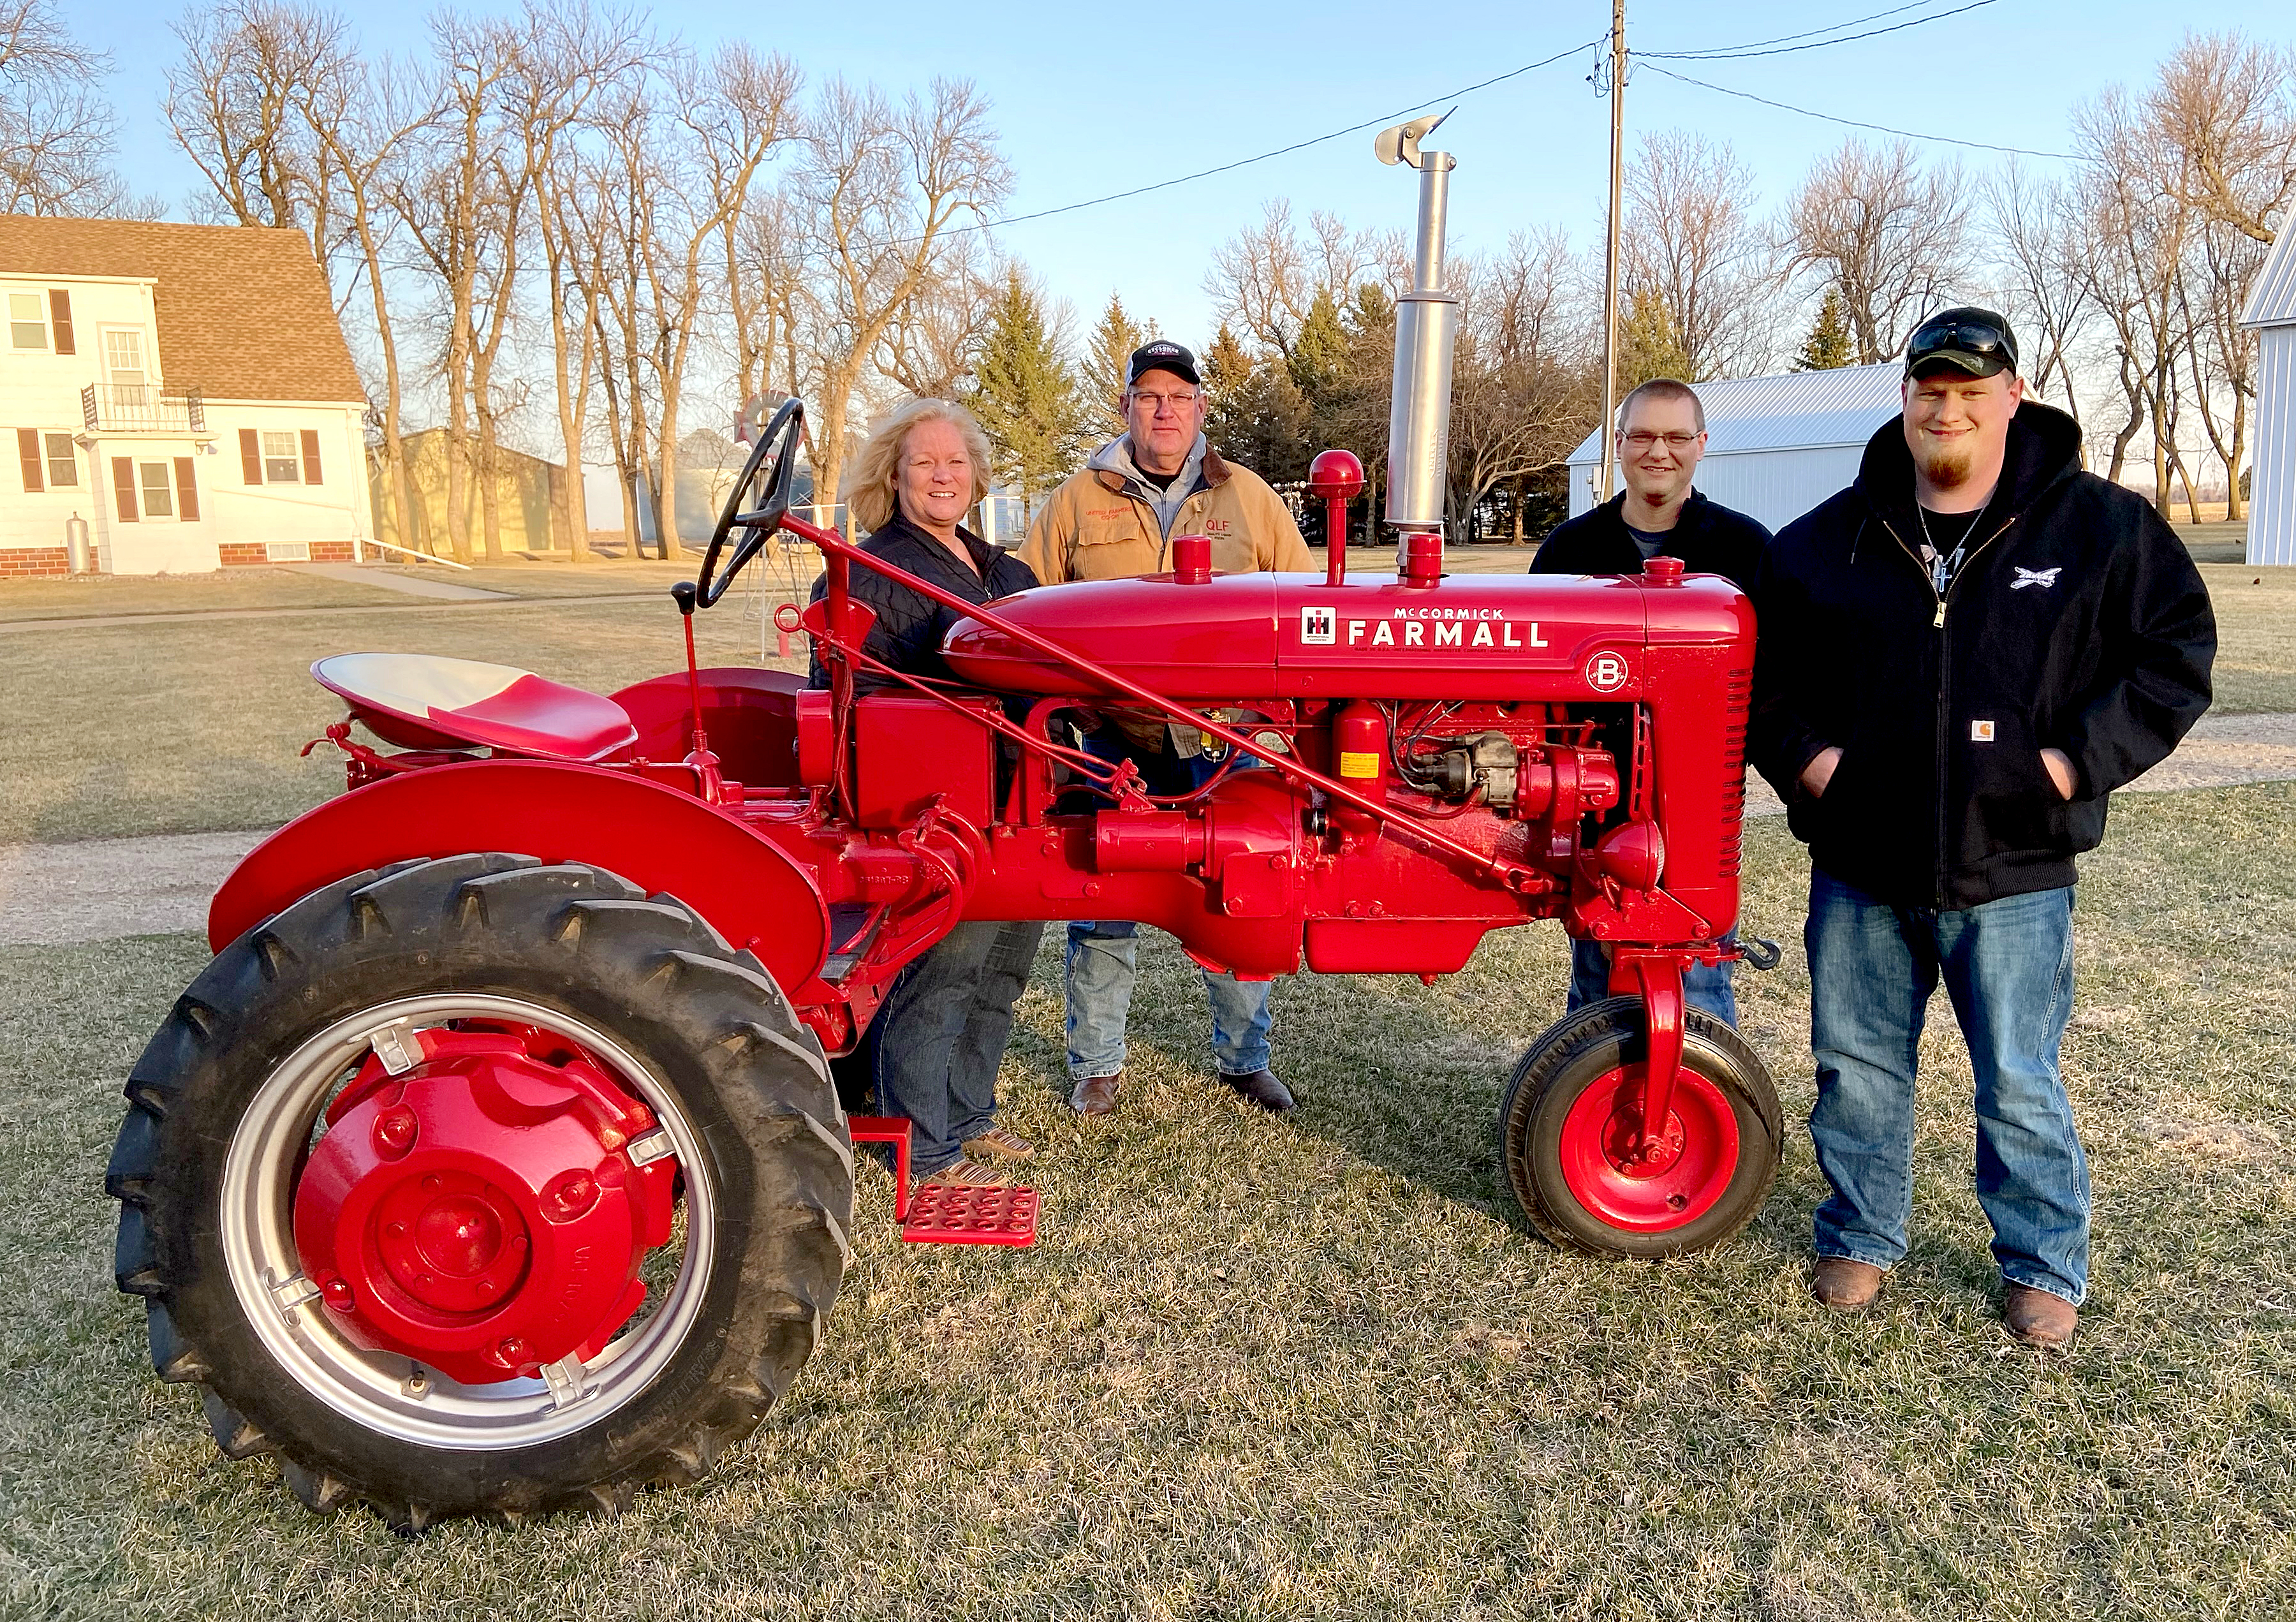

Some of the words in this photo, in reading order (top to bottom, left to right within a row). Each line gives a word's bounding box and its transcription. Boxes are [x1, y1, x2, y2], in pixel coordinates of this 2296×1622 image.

[1206, 519, 1231, 531] QLF
[1394, 608, 1504, 621] McCORMICK
[1348, 620, 1549, 647] FARMALL
[1597, 659, 1619, 685] B
